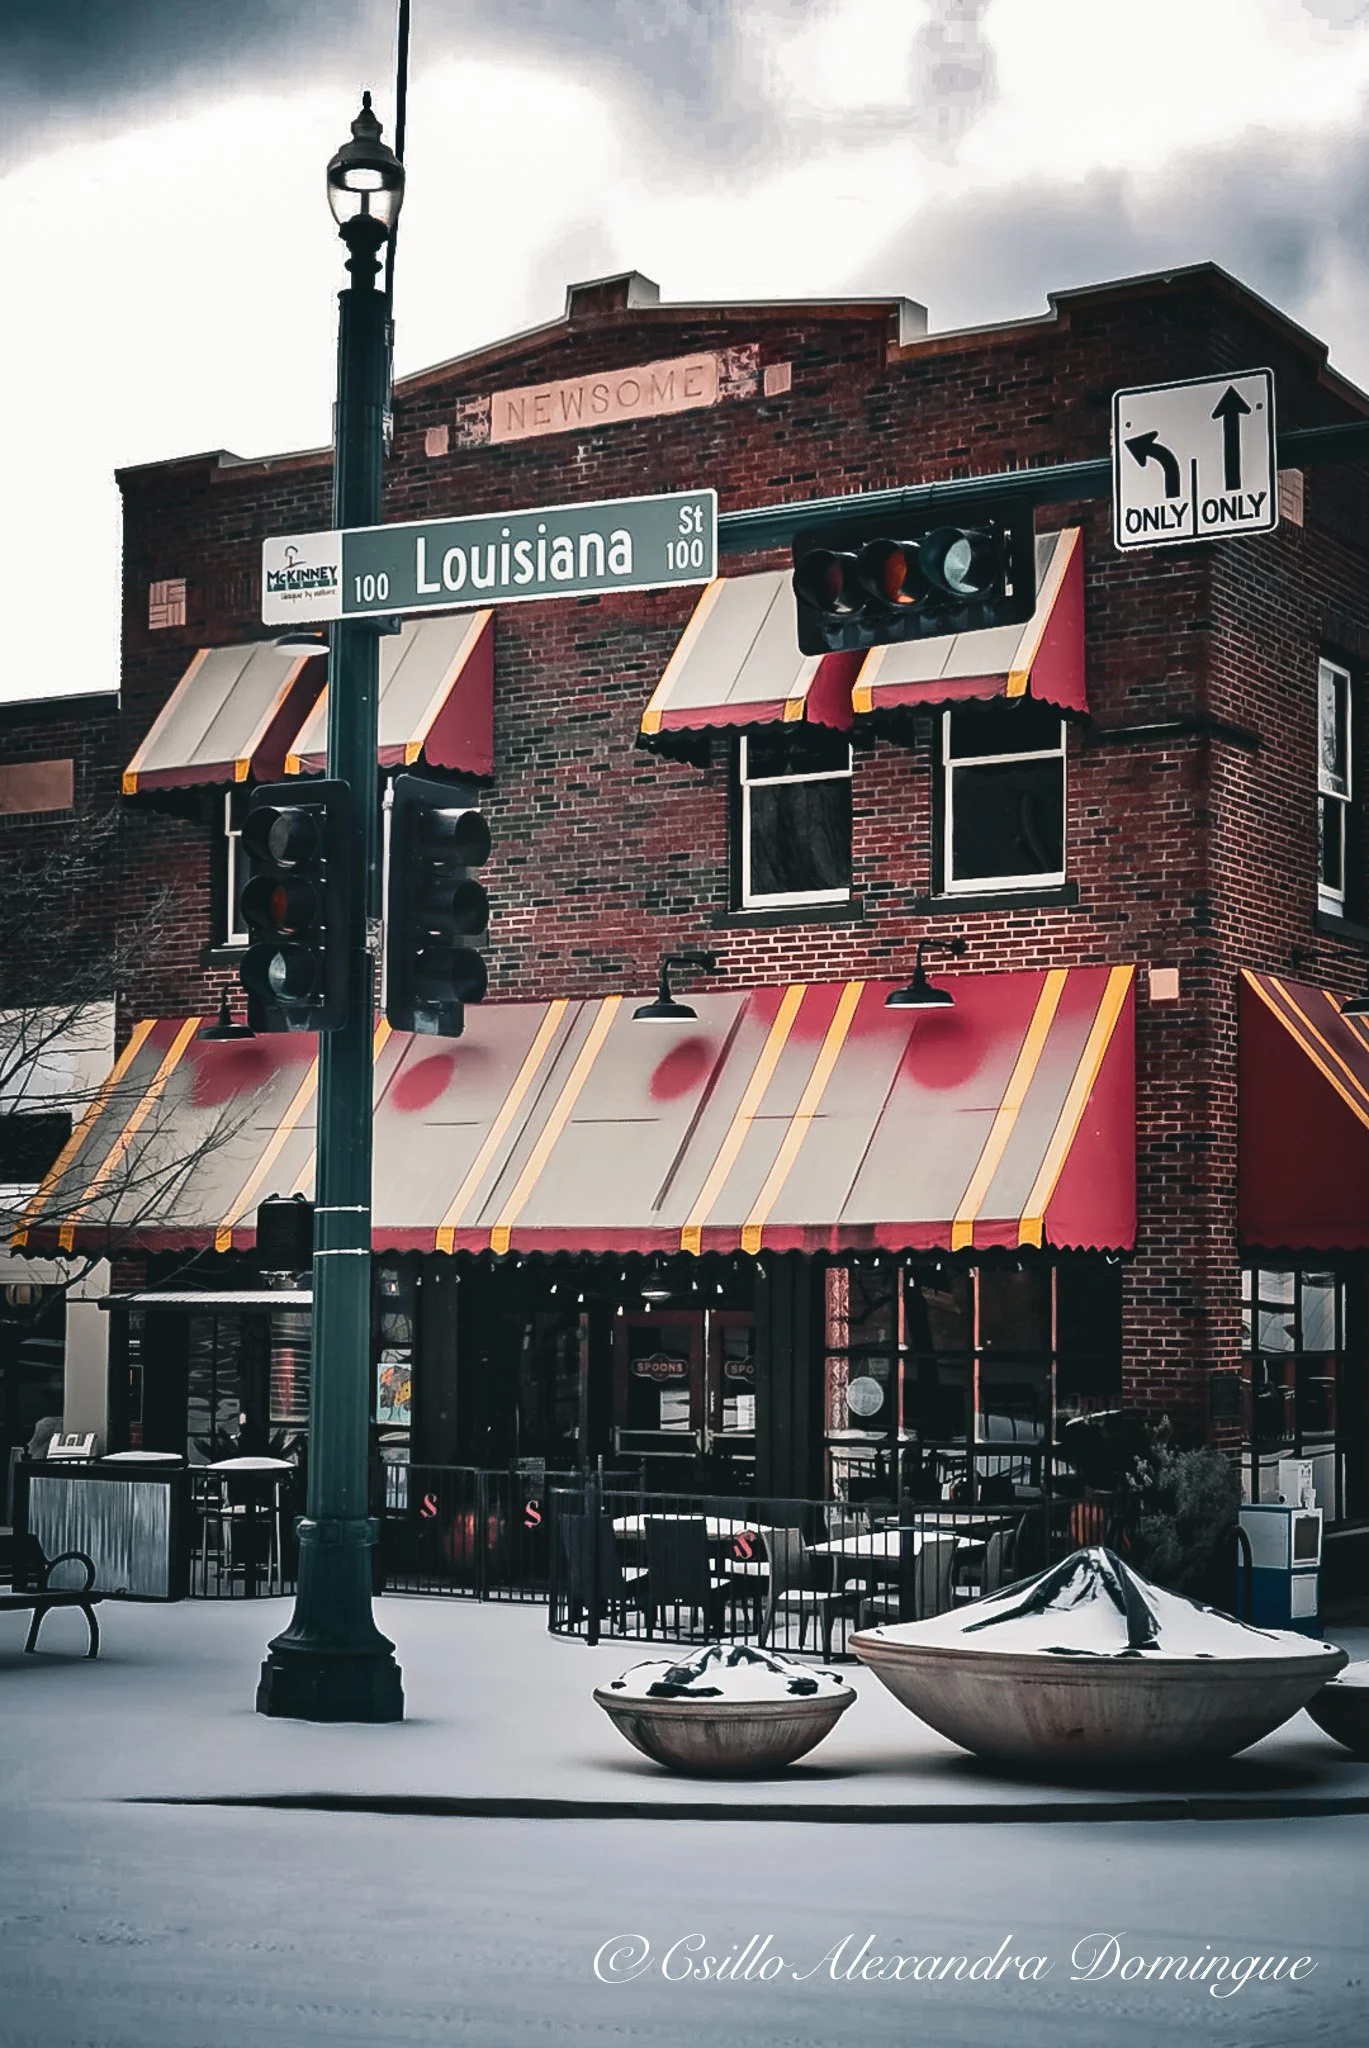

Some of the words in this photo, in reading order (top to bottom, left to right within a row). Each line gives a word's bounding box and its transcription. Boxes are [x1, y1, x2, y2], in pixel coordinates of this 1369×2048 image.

[506, 364, 704, 432] NEWSOME
[1125, 502, 1190, 534] ONLY
[1201, 491, 1267, 525] ONLY
[354, 572, 389, 603] 100
[416, 523, 634, 595] Louisiana
[678, 504, 704, 535] St
[666, 538, 704, 570] 100
[636, 1362, 683, 1373] SPOONS
